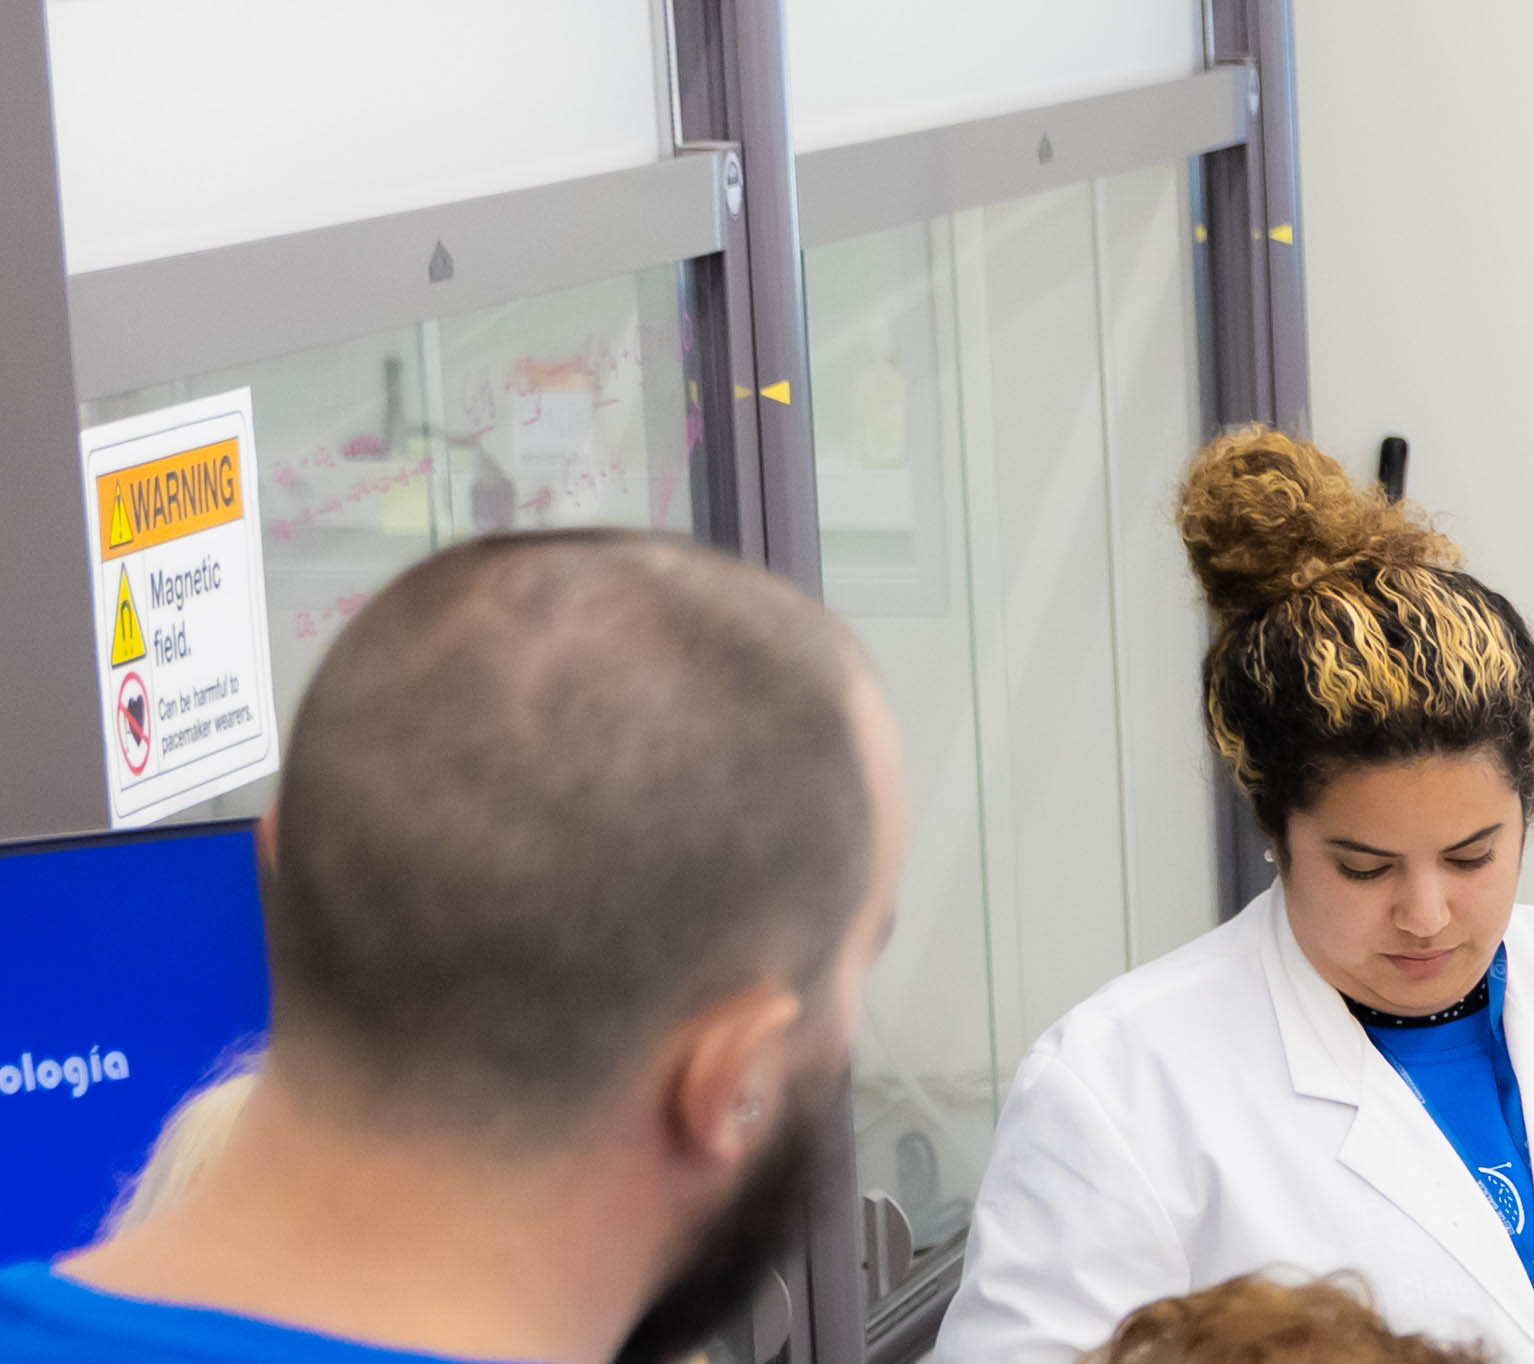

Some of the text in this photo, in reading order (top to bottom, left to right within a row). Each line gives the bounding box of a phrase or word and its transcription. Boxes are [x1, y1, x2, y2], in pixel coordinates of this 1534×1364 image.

[130, 454, 235, 534] WARNING
[150, 553, 222, 612] Magnetic
[153, 620, 192, 667] field.
[158, 697, 178, 721] Can
[179, 690, 191, 713] be
[0, 1044, 130, 1099] ología
